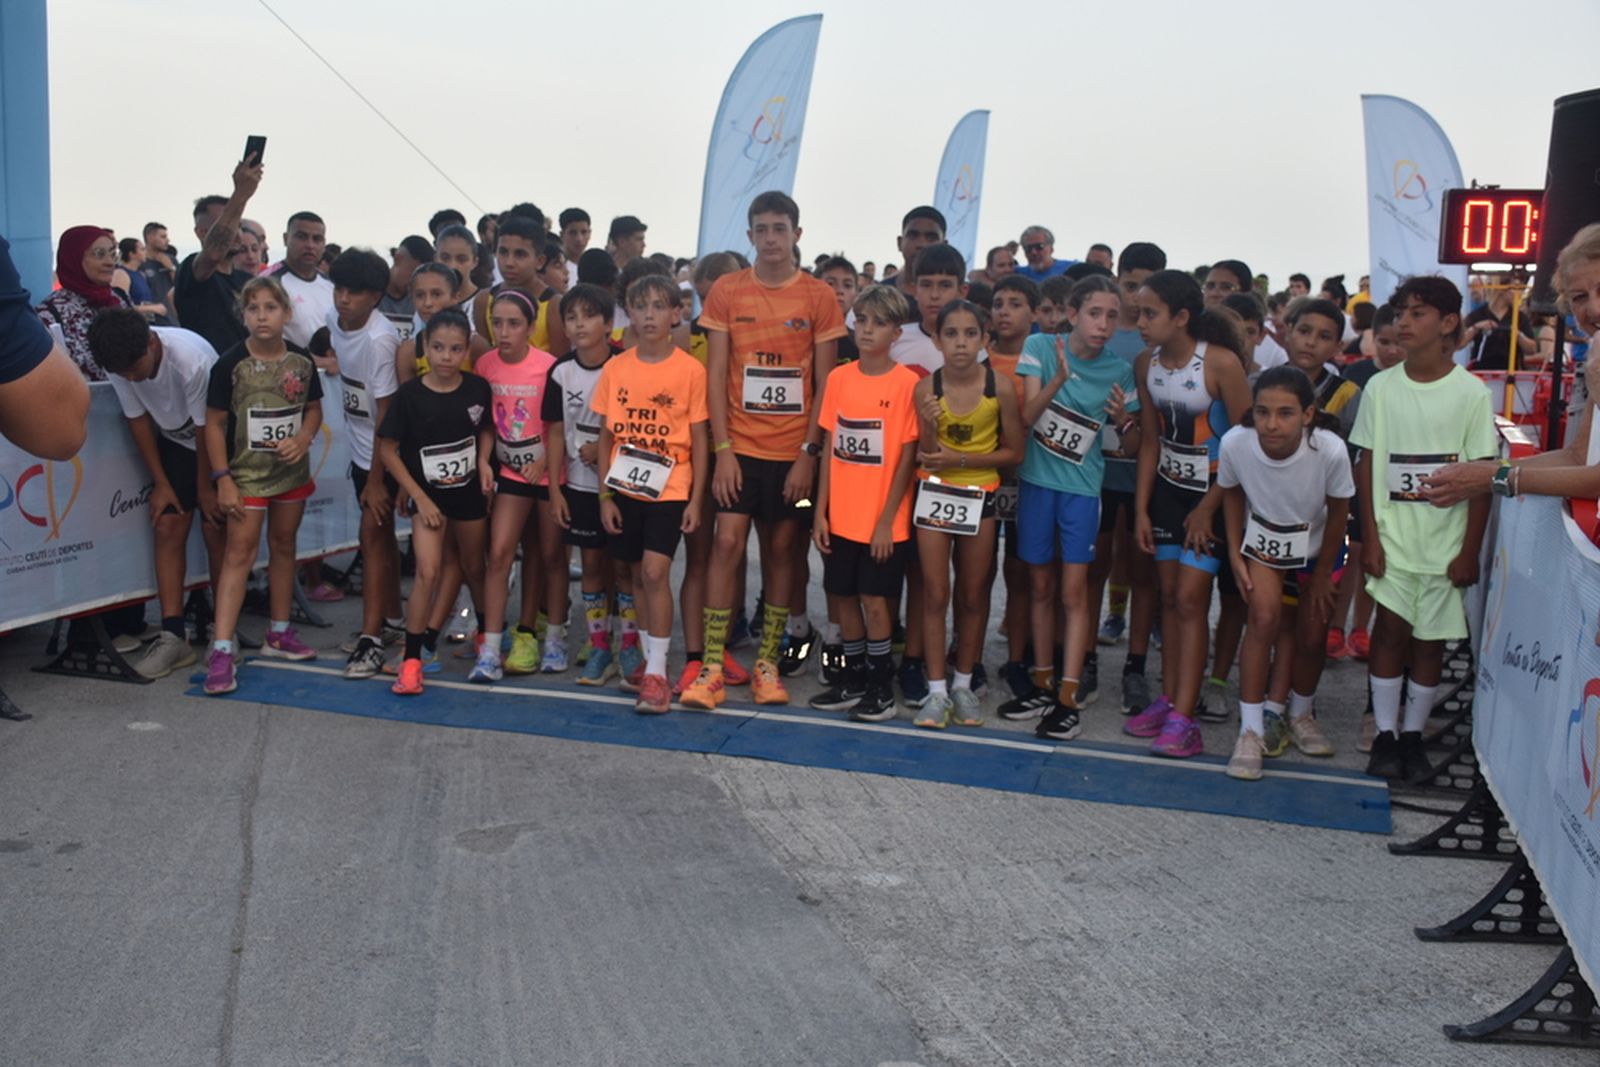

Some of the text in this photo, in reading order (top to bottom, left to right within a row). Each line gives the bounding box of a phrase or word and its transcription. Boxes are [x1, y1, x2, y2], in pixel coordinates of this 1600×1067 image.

[756, 351, 782, 365] TRI
[343, 390, 360, 409] 39
[761, 386, 786, 404] 48
[626, 408, 657, 420] TRI
[838, 434, 870, 455] 184
[1043, 420, 1083, 450] 318
[437, 457, 469, 479] 327
[627, 466, 651, 485] 44
[1164, 454, 1197, 480] 333
[929, 500, 968, 524] 293
[58, 541, 94, 555] DEPORTES
[1256, 533, 1294, 558] 381
